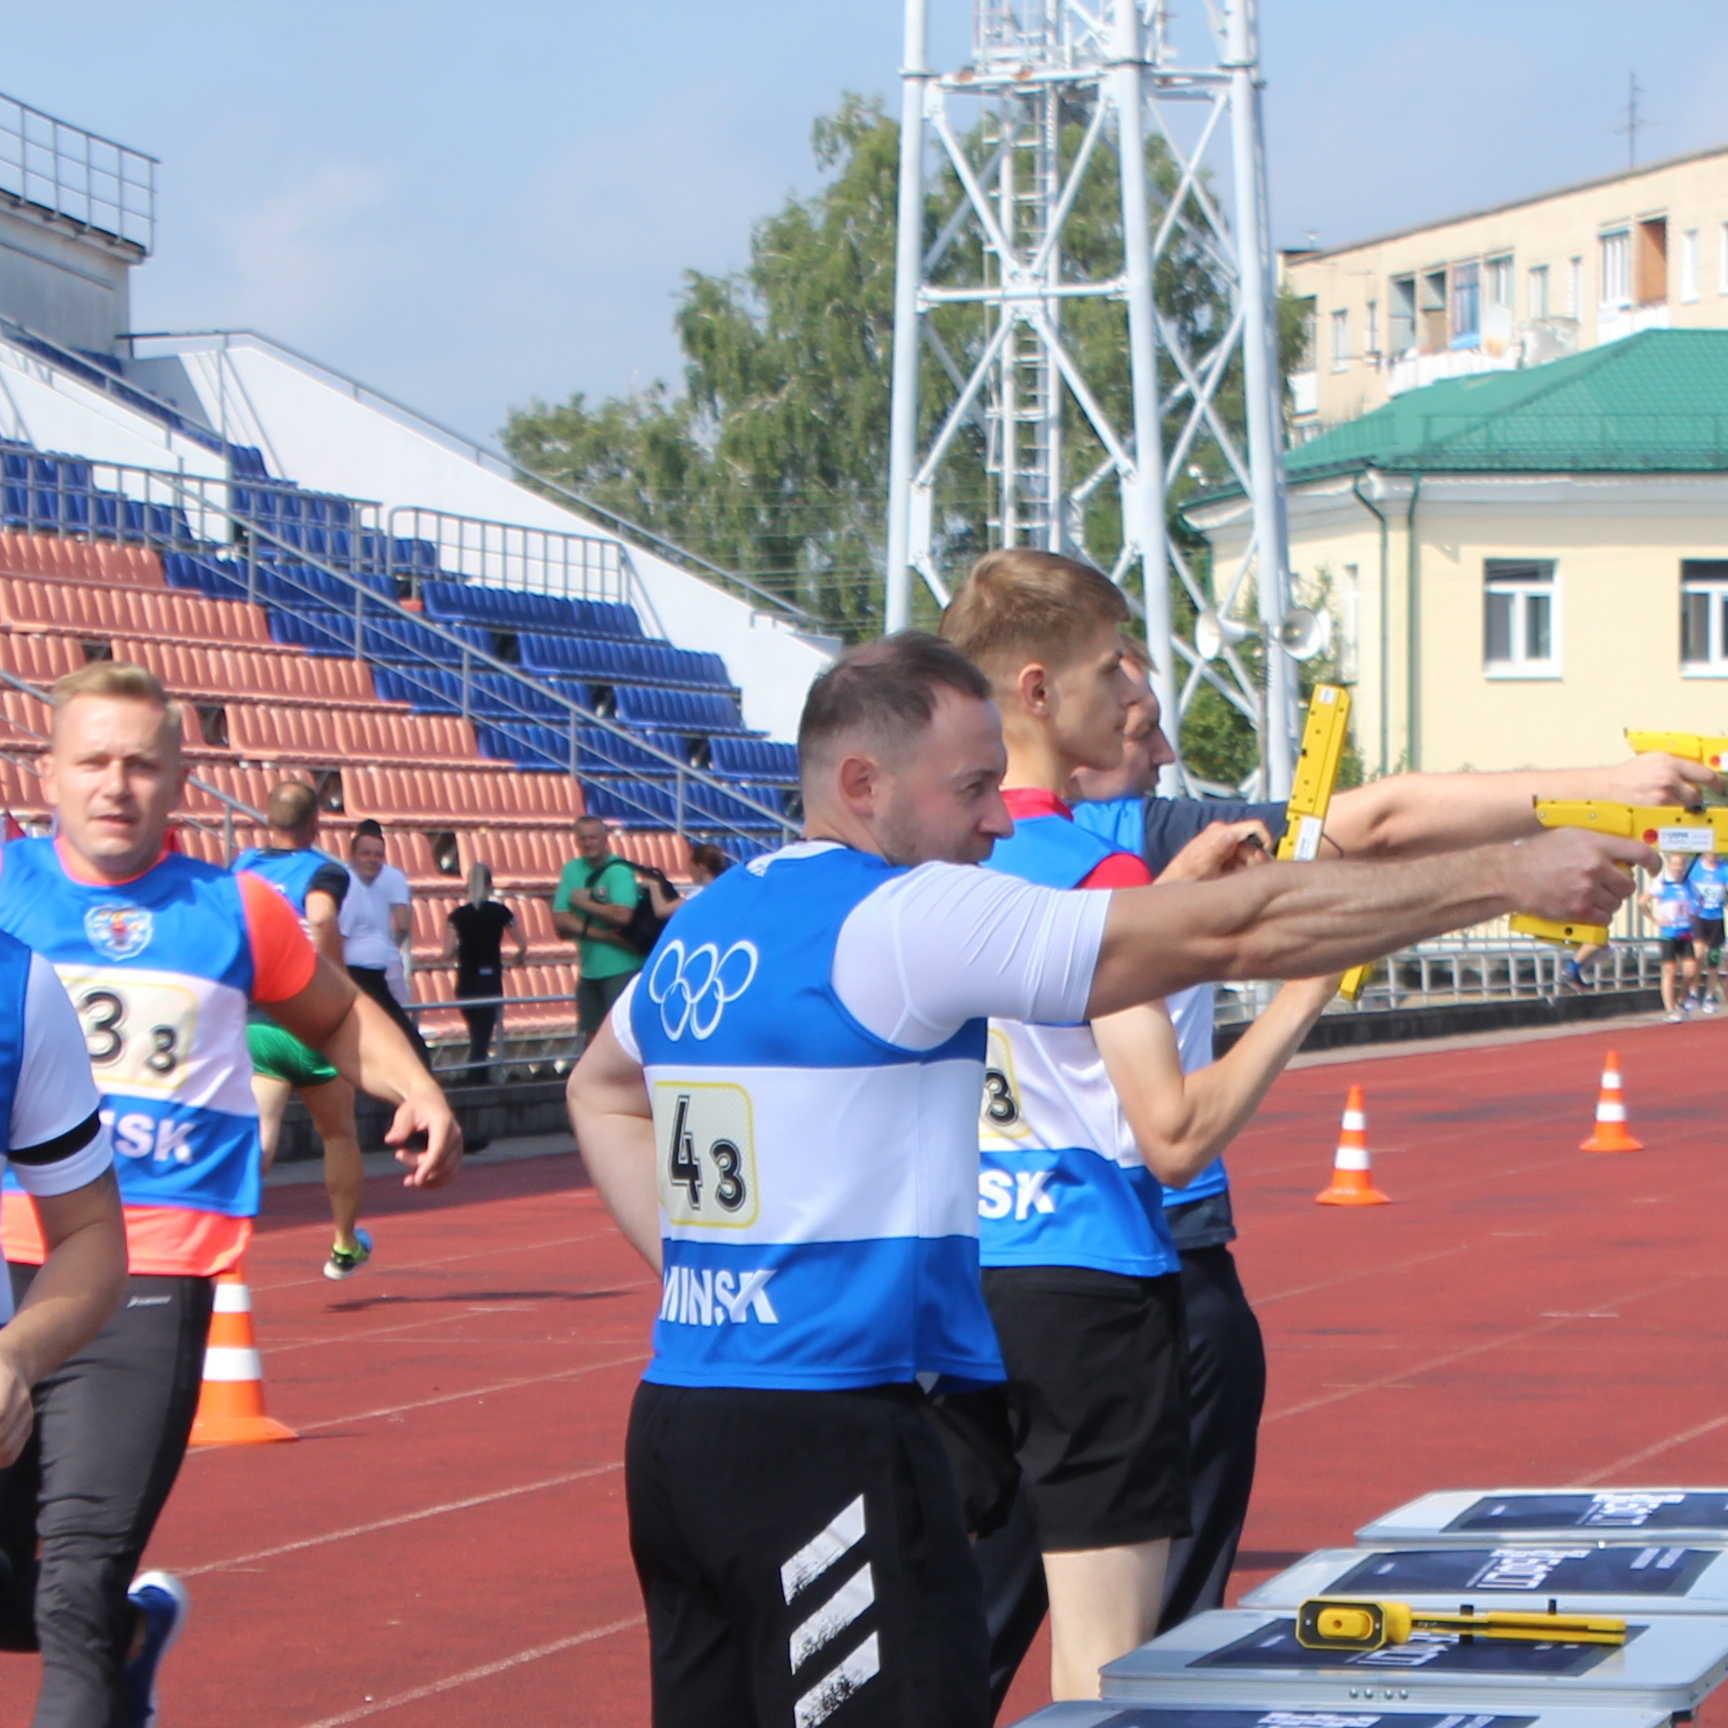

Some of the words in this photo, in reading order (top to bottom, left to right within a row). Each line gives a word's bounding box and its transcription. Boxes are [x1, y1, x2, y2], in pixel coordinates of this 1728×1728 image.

[79, 988, 126, 1068] 3
[148, 1025, 178, 1074] 3
[986, 1068, 1018, 1126] 3
[669, 1095, 703, 1211] 4
[710, 1138, 746, 1213] 3
[658, 1265, 780, 1327] MINSK
